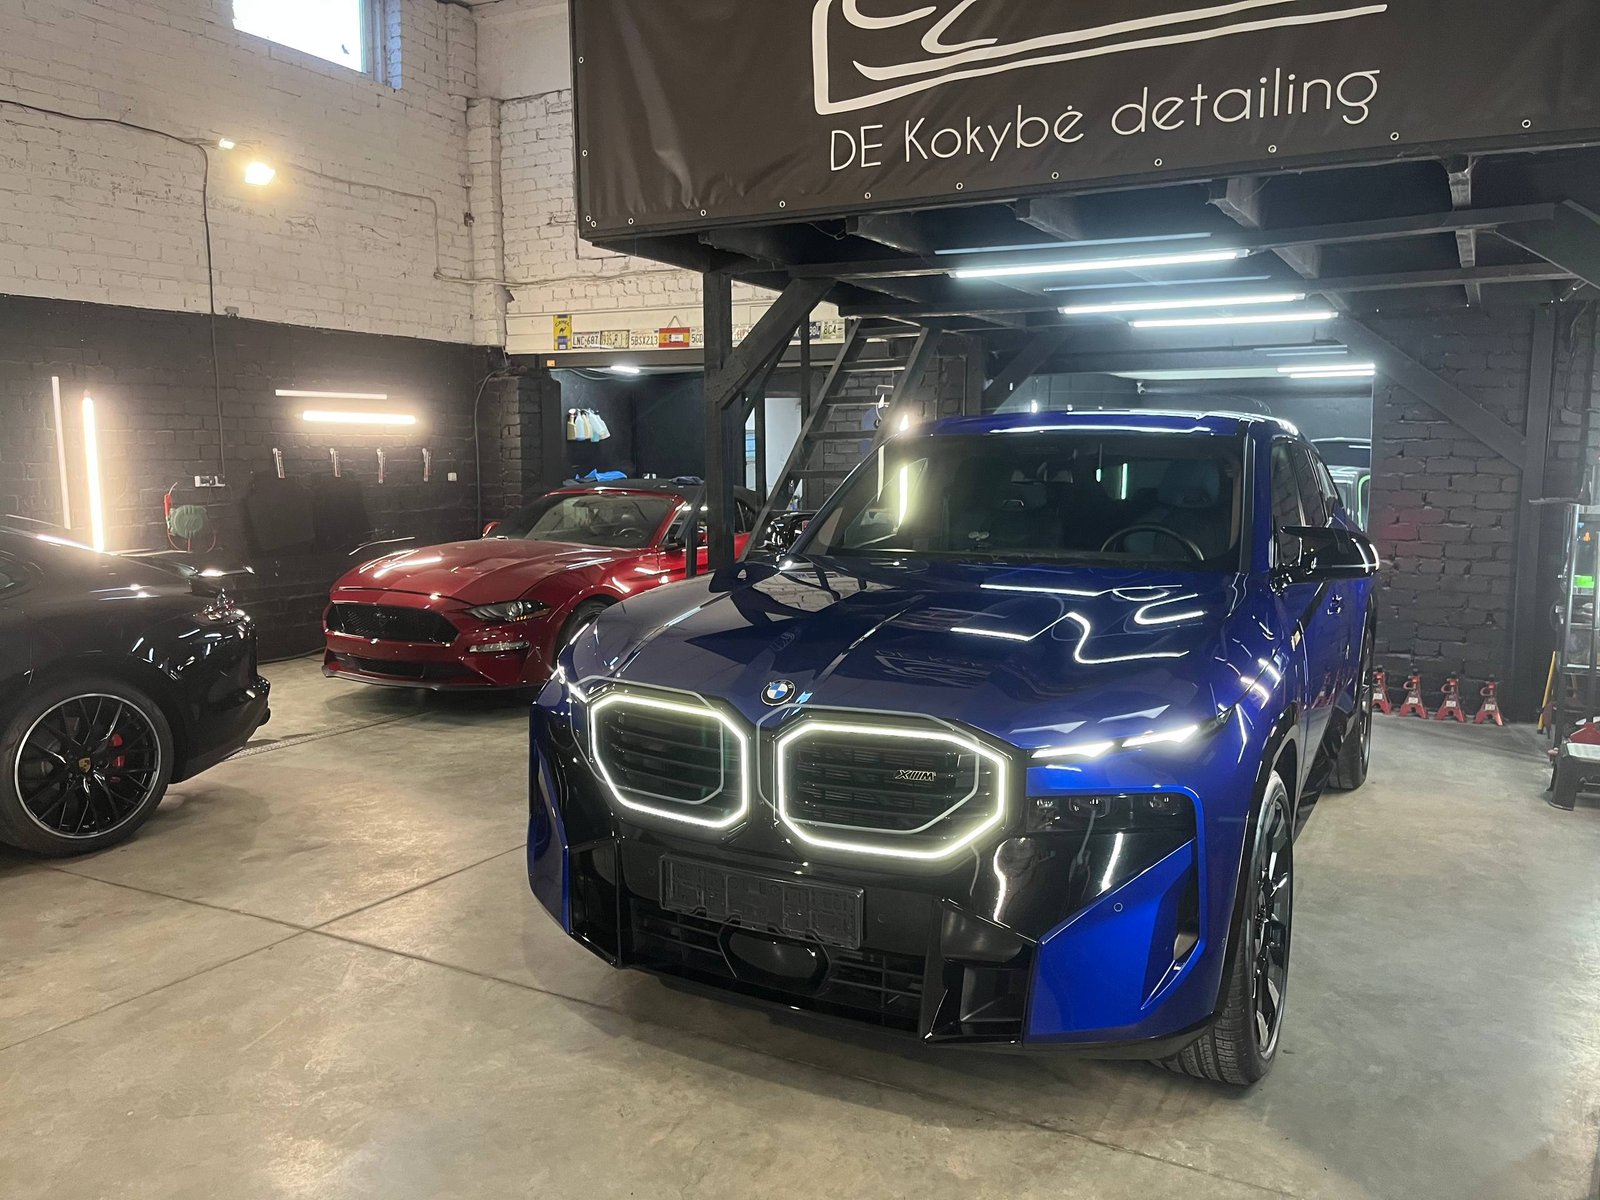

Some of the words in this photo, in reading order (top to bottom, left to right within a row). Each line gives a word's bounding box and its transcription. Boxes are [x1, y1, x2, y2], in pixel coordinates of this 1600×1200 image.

[829, 123, 885, 171] DE
[903, 103, 1085, 163] Kokybė
[1110, 67, 1381, 136] detailing
